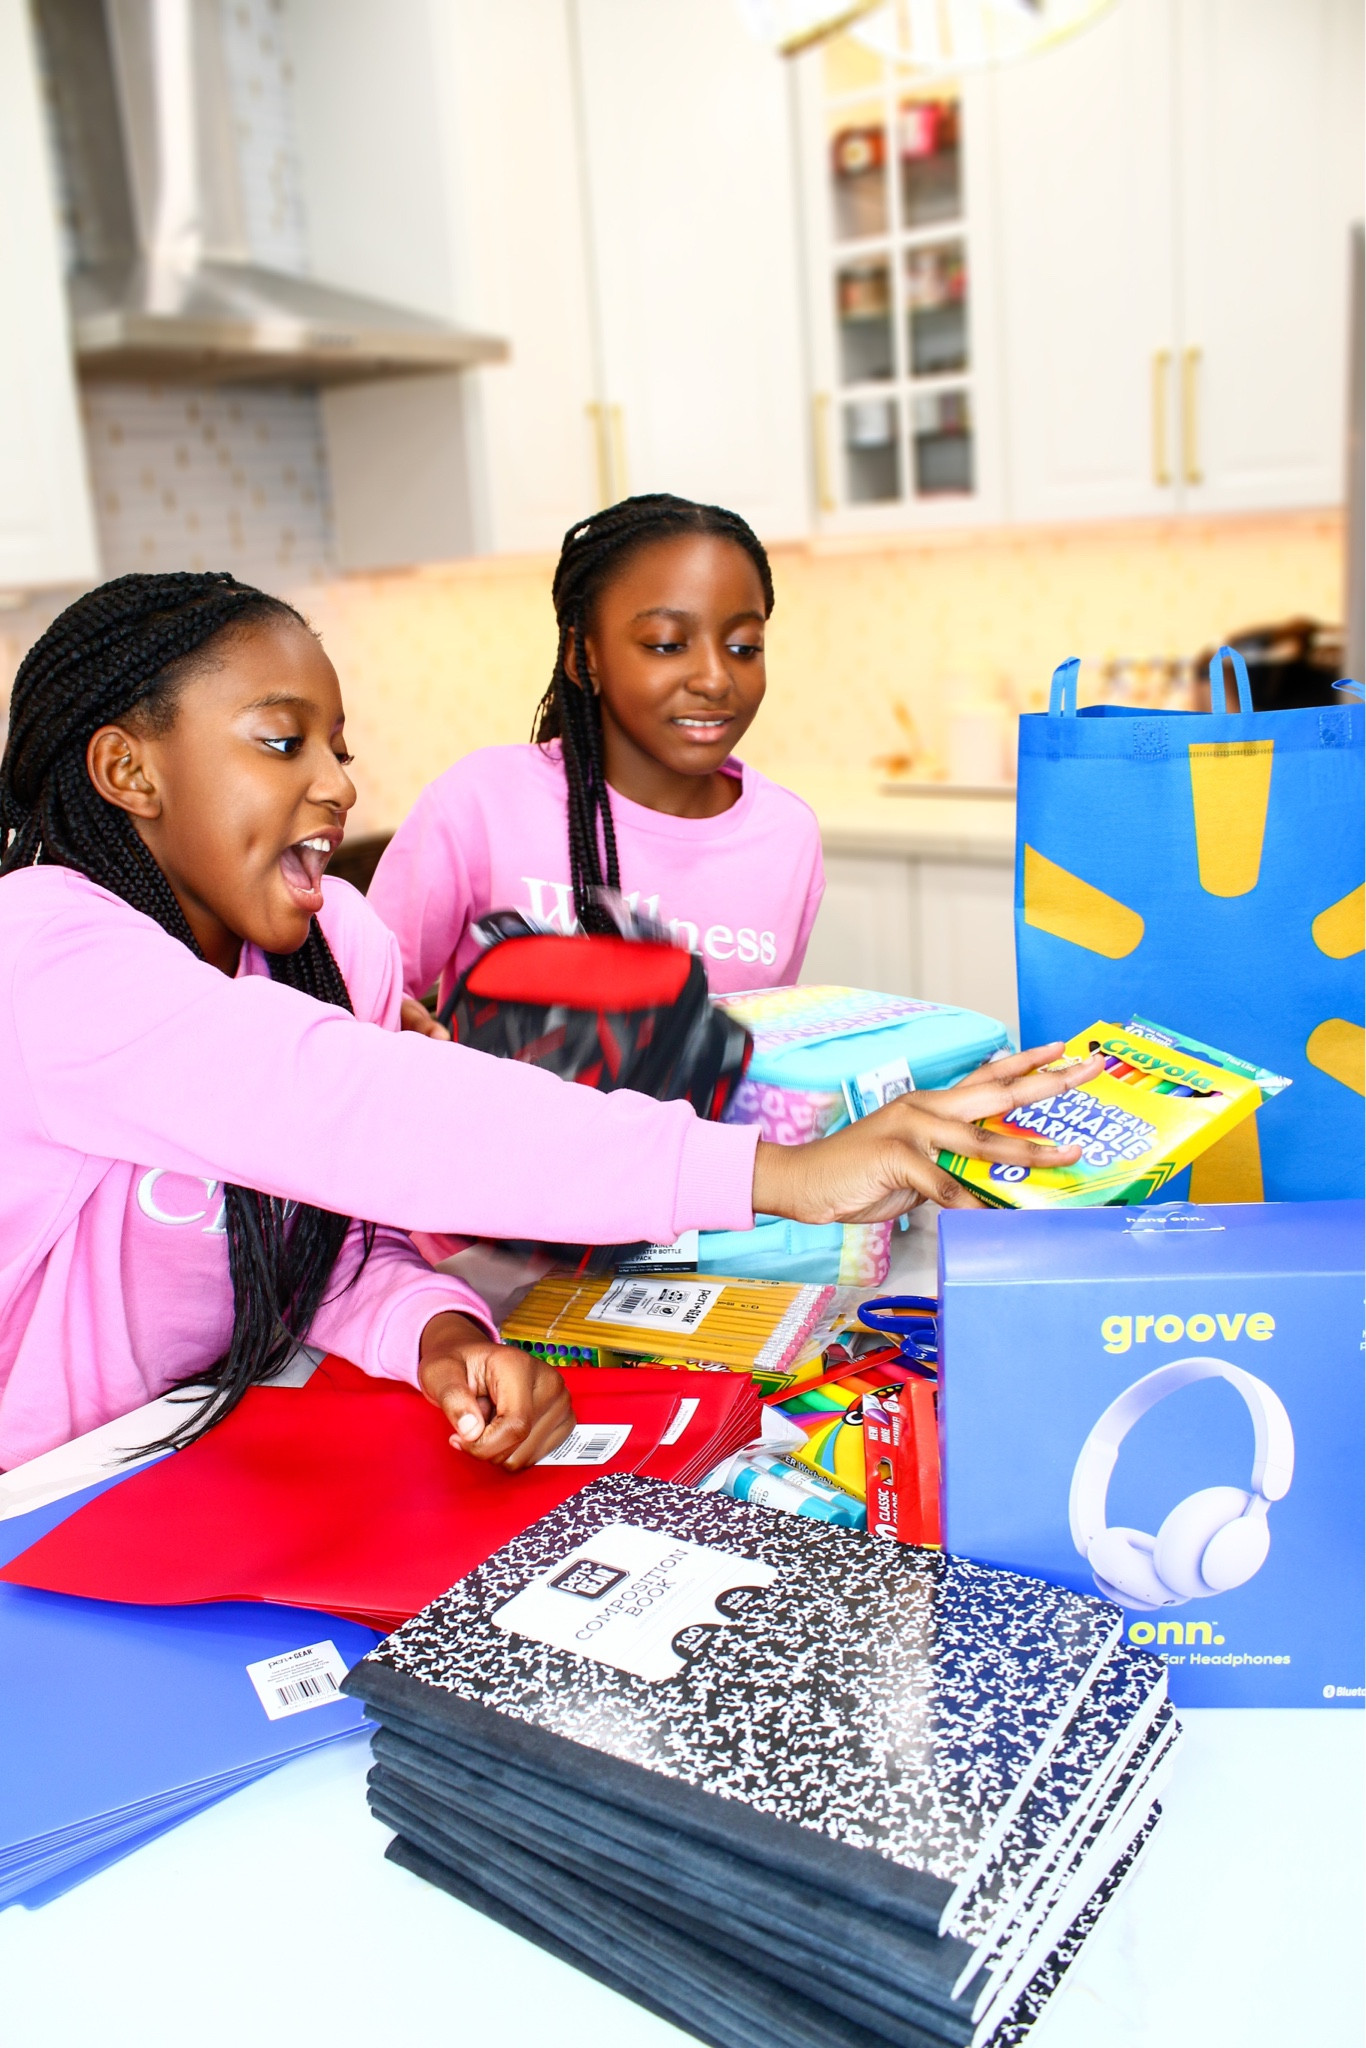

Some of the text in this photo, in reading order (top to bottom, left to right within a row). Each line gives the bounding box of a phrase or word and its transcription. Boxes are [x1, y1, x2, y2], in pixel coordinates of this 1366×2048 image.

[1102, 1038, 1214, 1091] Crayola
[1029, 1096, 1150, 1160] ASHABLE
[1058, 1089, 1155, 1137] TRA-CLEAN
[1101, 1312, 1276, 1354] groove
[877, 1487, 891, 1522] CLASSIC
[575, 1549, 689, 1641] COMPOSITION
[625, 1578, 677, 1617] BOOK
[676, 1626, 703, 1649] 100
[1128, 1621, 1225, 1645] onn.
[1190, 1653, 1291, 1667] Headphones
